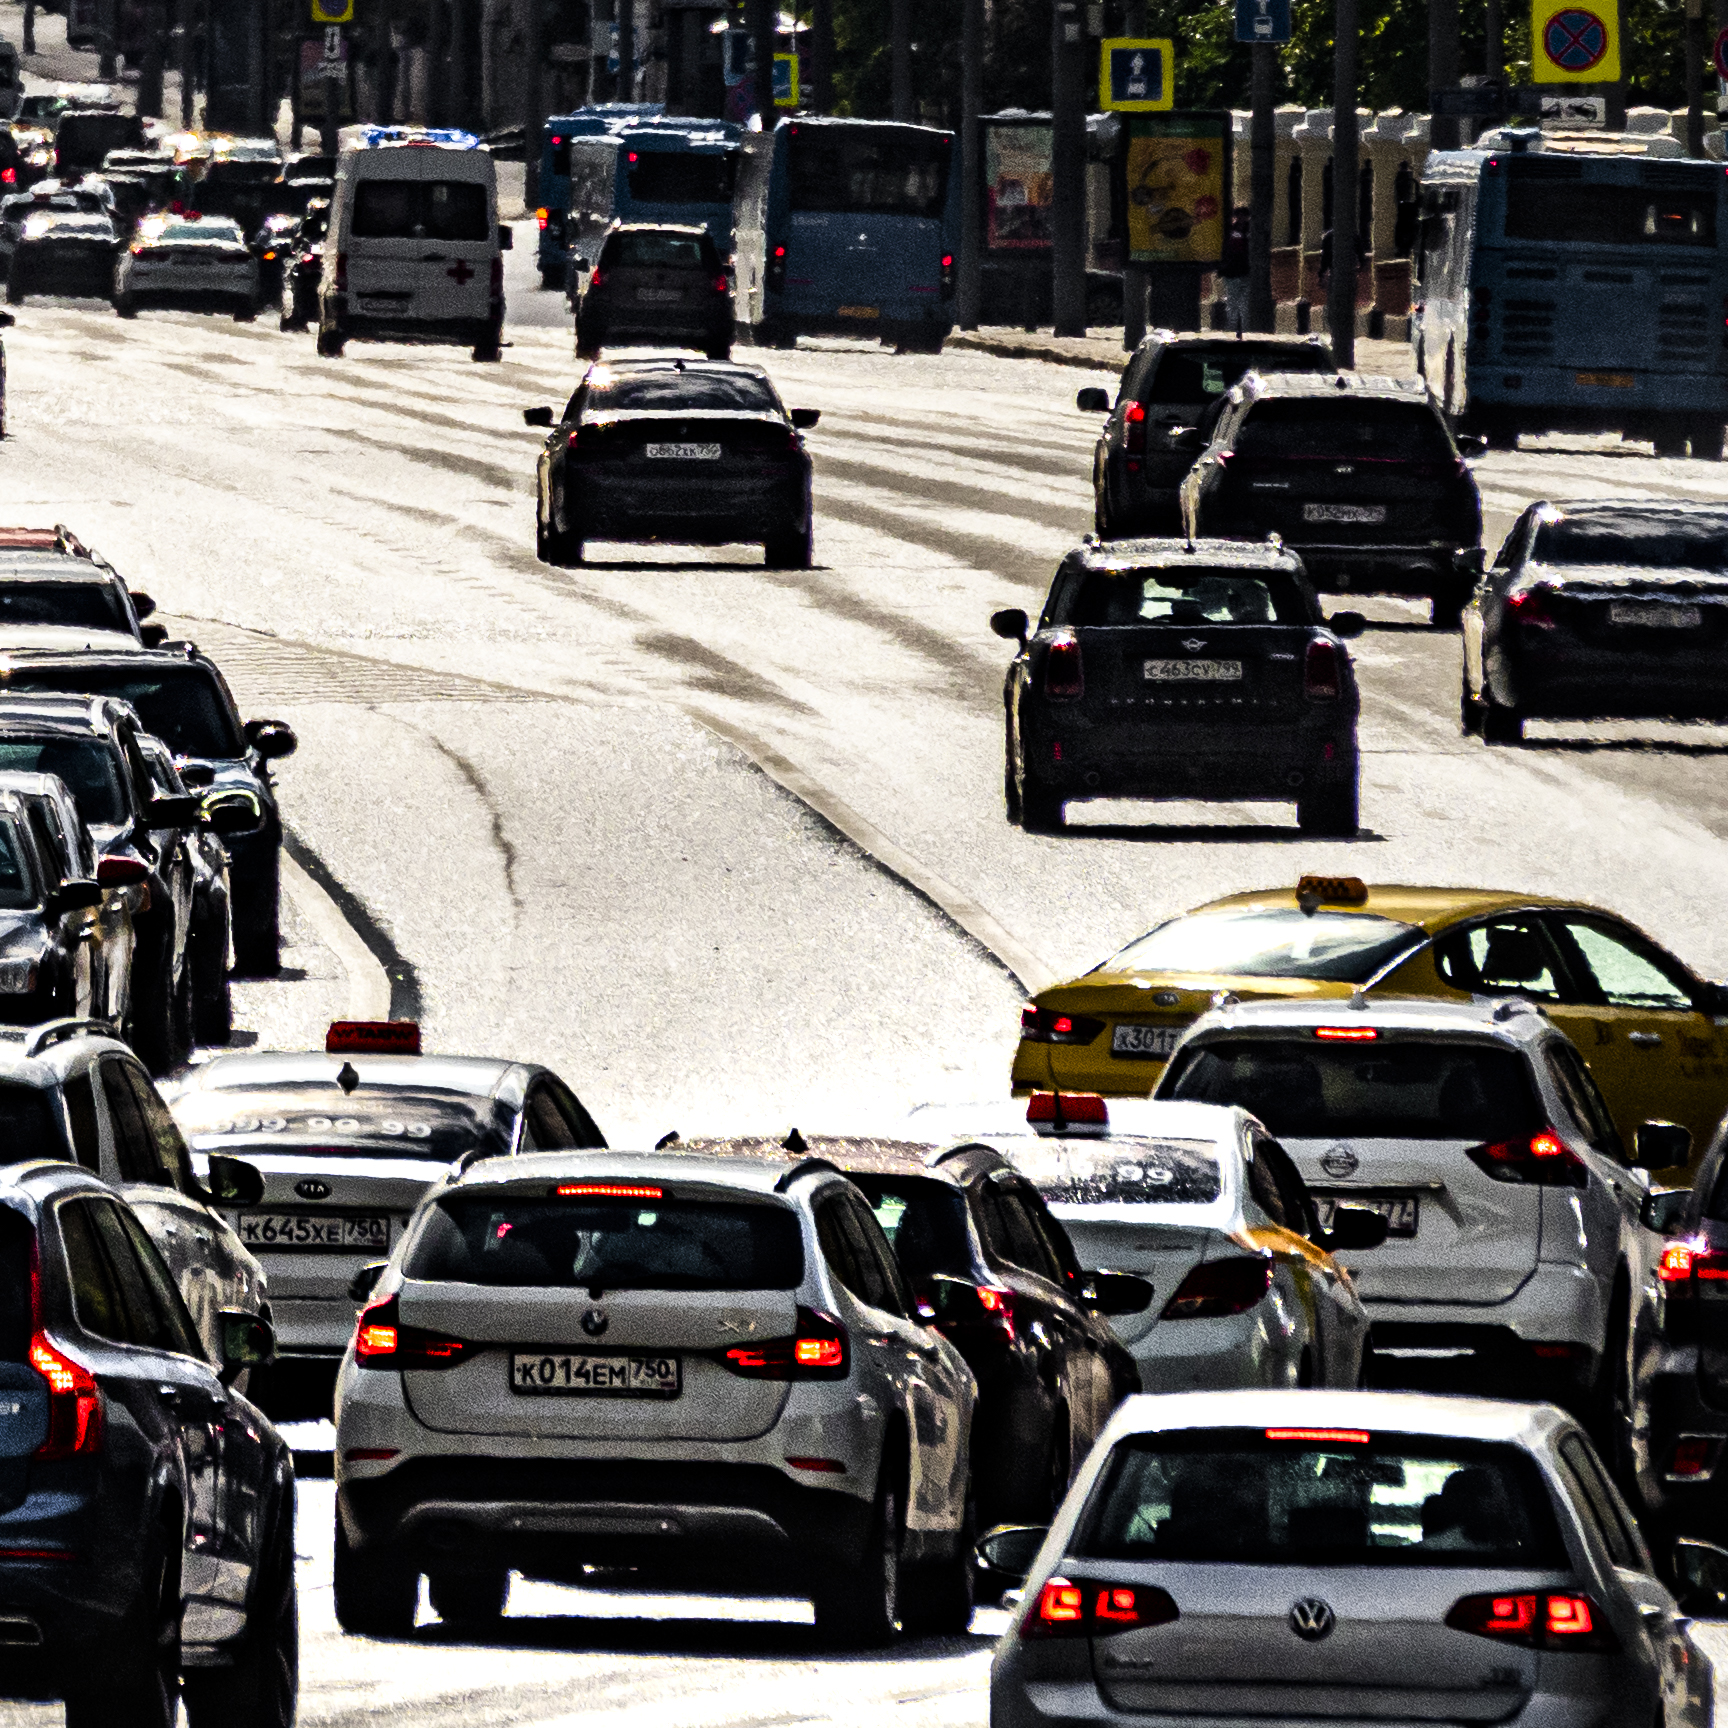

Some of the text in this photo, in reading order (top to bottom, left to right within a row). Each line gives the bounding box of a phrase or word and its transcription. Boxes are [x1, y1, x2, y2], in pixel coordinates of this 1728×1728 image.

[246, 1217, 382, 1244] К645ХЕ 750
[522, 1357, 671, 1387] К014ЕМ 750
